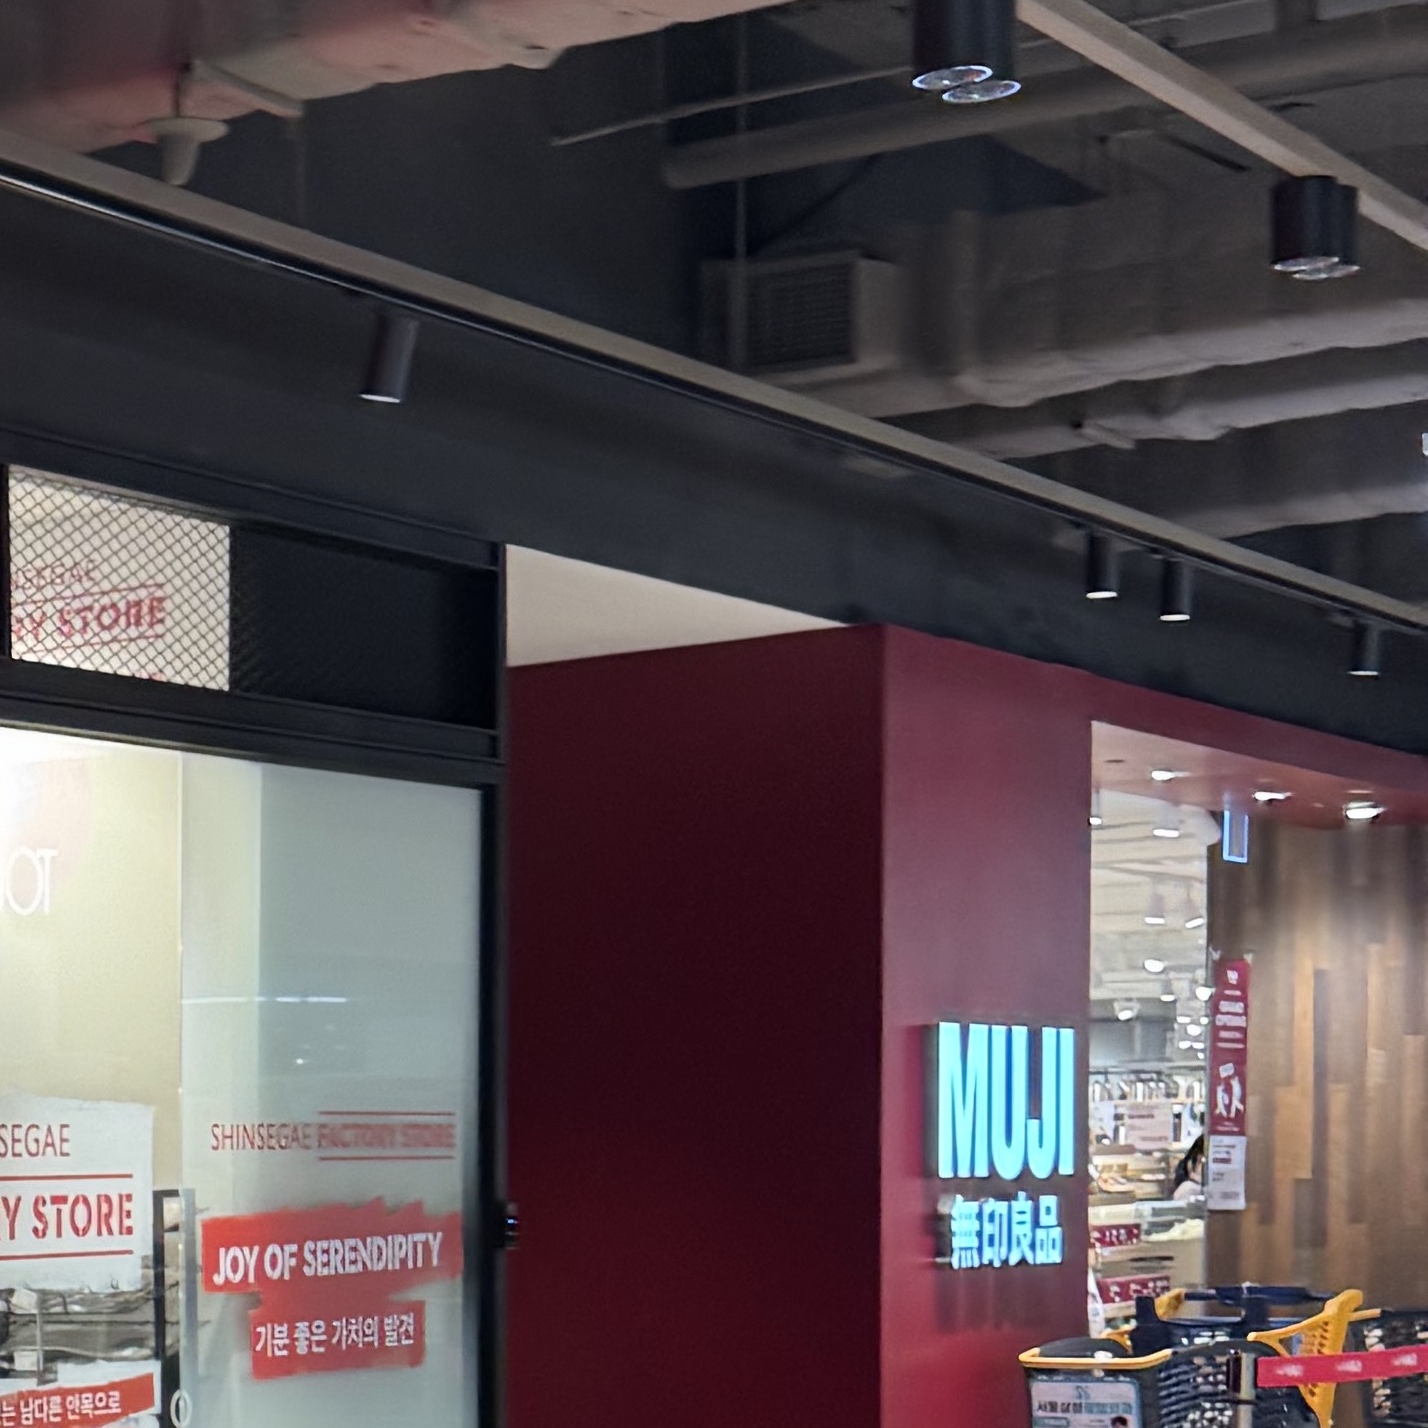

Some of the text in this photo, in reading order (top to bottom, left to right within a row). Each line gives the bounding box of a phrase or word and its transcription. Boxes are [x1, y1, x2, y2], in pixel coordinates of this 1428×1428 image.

[938, 1022, 1075, 1181] MUJI
[211, 1122, 312, 1151] SHINSEGAE
[32, 1193, 134, 1240] STORE
[950, 1190, 1063, 1270] 無印良品
[212, 1231, 443, 1286] JOY OF SERENDIPITY
[255, 1311, 415, 1358] 기분 좋은 가치의 발견
[19, 1394, 63, 1426] 남다른
[65, 1390, 122, 1421] 안목으로
